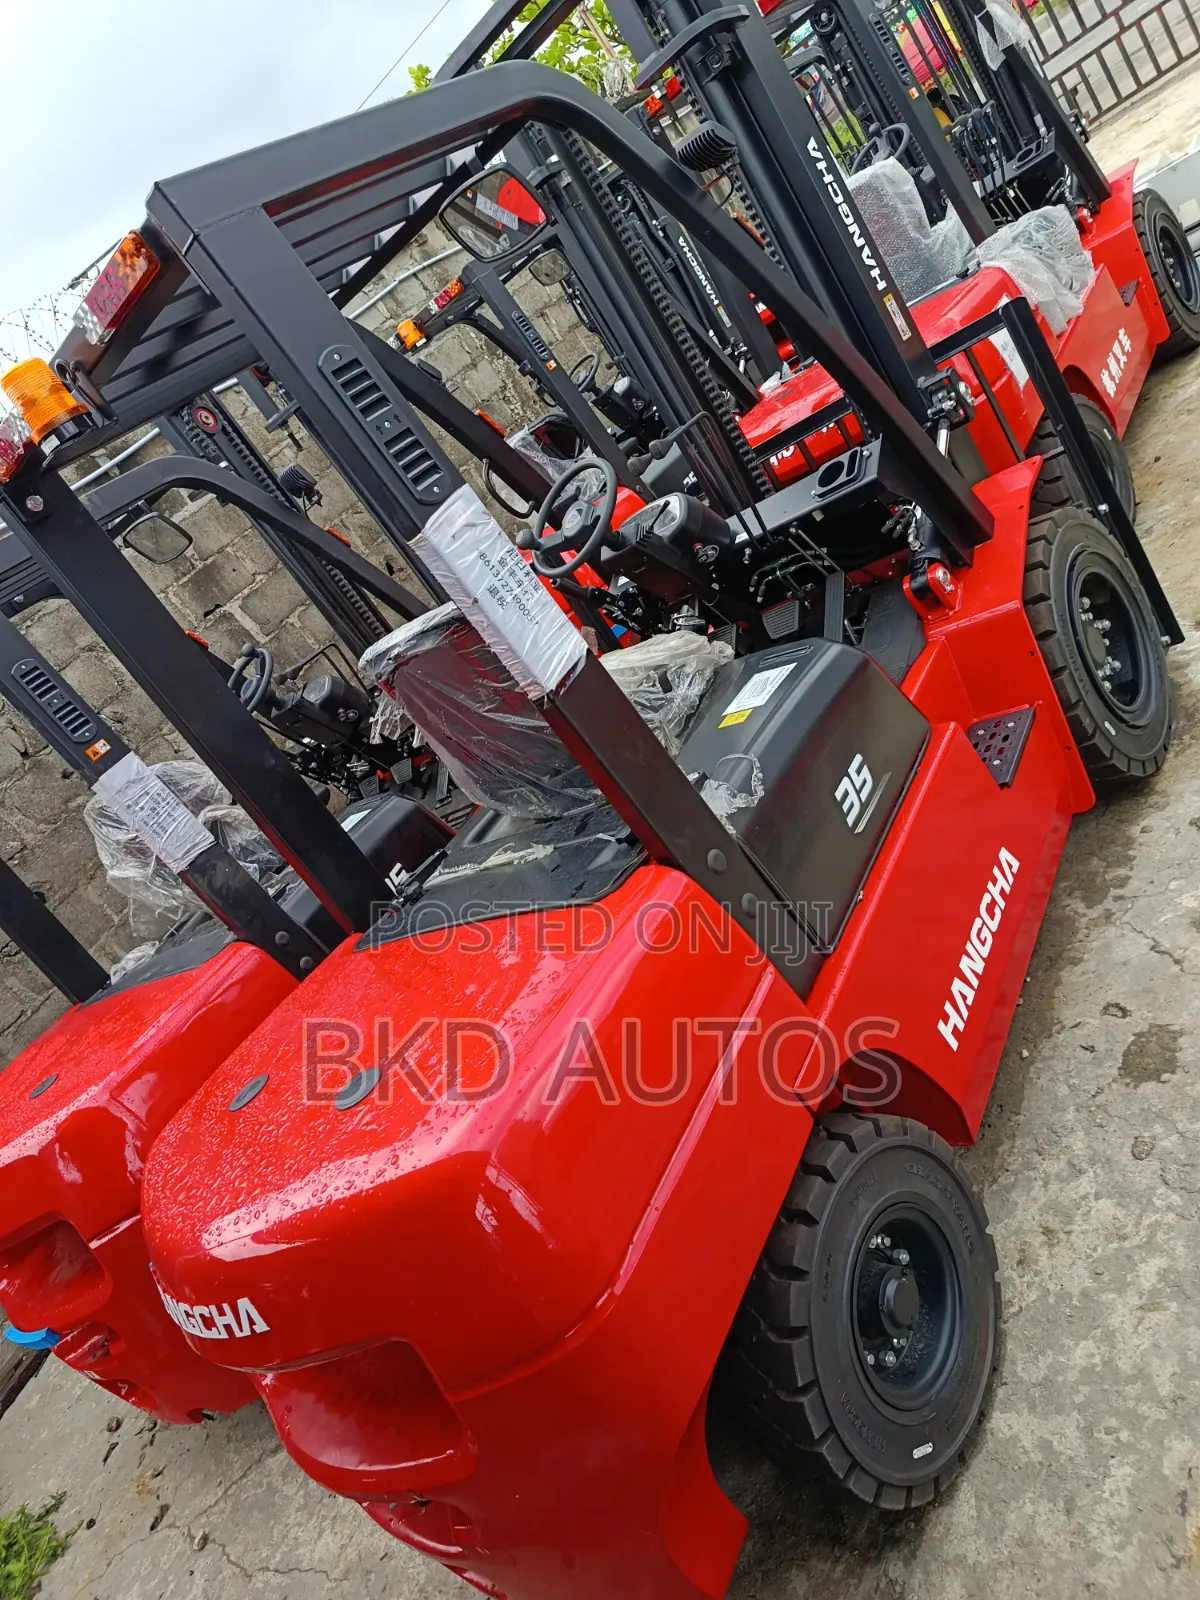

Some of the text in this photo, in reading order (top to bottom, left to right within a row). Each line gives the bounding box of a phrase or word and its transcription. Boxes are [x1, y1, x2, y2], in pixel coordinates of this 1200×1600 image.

[806, 136, 887, 291] HANGCHA
[677, 236, 720, 305] HANGCHA
[486, 582, 511, 610] 退税
[834, 753, 874, 827] 35
[937, 846, 1020, 1052] HANGCHA
